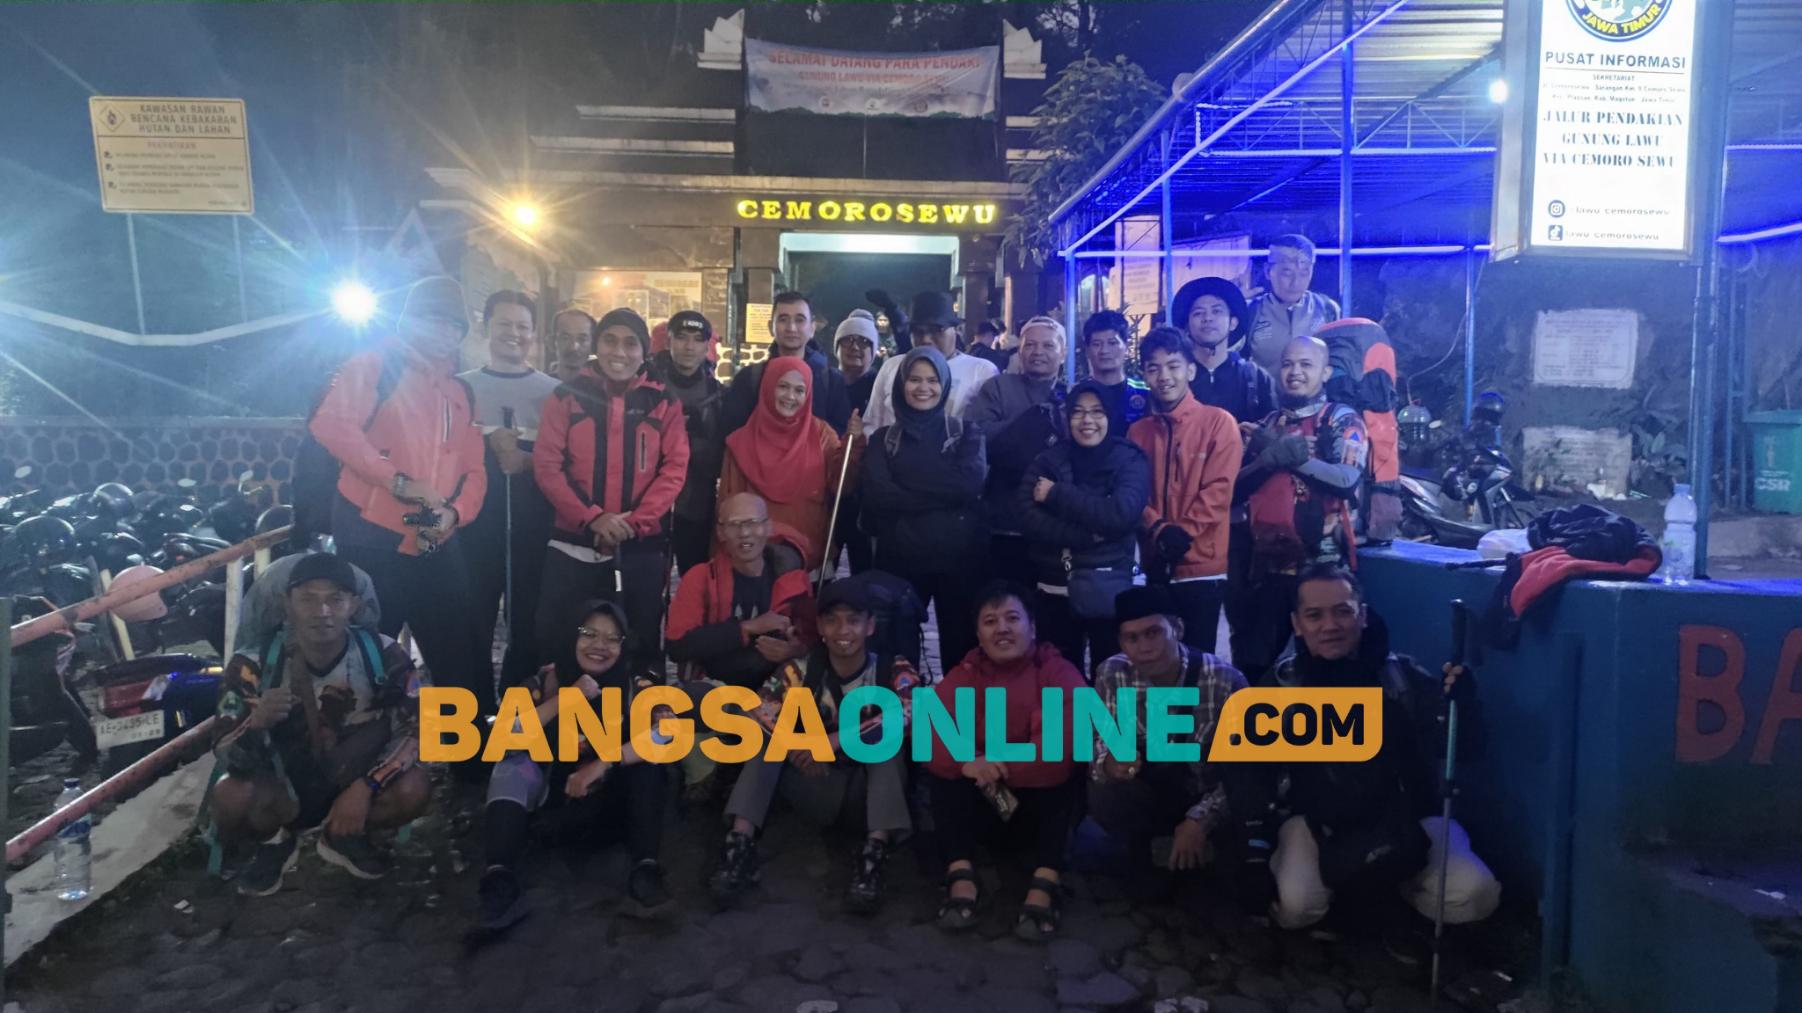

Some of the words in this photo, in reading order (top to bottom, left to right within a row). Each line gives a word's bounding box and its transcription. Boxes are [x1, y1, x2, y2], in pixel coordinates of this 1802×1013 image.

[1582, 13, 1619, 35] JAWA
[1621, 4, 1662, 34] TIMUR
[831, 53, 881, 69] DATANG
[885, 55, 919, 69] PARA
[1545, 51, 1595, 65] PUSAT
[1600, 54, 1686, 69] INFORMASI
[140, 104, 186, 114] KAWASAN
[190, 105, 225, 114] RAWAN
[130, 113, 176, 123] BENCANA
[180, 114, 237, 124] KEBAKARAN
[1543, 110, 1591, 124] JALUR
[1597, 111, 1683, 126] PENDAKIAN
[175, 124, 195, 134] DAN
[199, 124, 231, 134] LAHAN
[1562, 133, 1620, 146] GUNUNG
[1625, 134, 1663, 147] LAWU
[1543, 152, 1568, 164] VIA
[1572, 153, 1633, 167] CEMORO
[736, 200, 996, 225] CEMOROSEWU
